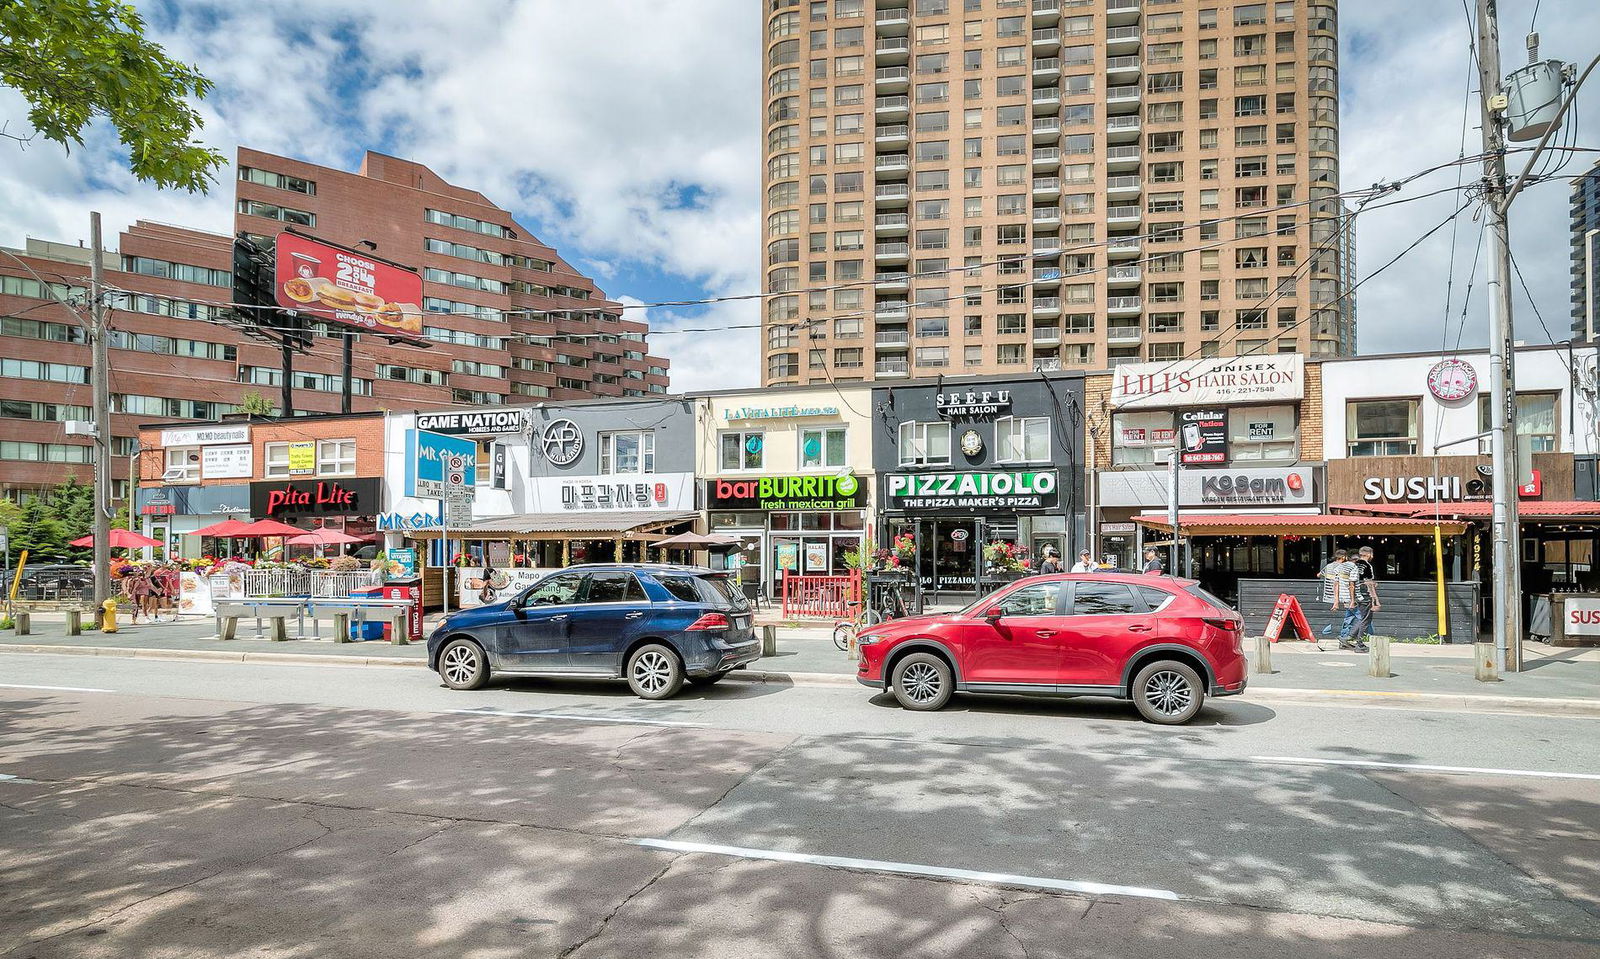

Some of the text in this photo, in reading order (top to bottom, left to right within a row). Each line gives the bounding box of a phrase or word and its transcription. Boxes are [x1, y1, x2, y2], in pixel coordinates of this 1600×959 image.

[336, 253, 375, 271] CHOOSE
[336, 262, 353, 282] 2
[336, 280, 374, 295] BREAKFAST
[1212, 363, 1276, 373] UNISEX
[1122, 371, 1192, 395] LILI'S
[1197, 371, 1294, 388] HAIR SALON
[936, 390, 1010, 406] SEEFU
[1238, 386, 1275, 394] 221-7548
[947, 405, 998, 415] HAIR SALON
[1182, 411, 1224, 421] Cellular
[418, 412, 520, 430] GAME NATION
[1250, 428, 1273, 436] RENT
[420, 445, 440, 461] MR.
[550, 452, 566, 463] HAIR
[888, 472, 1056, 497] PIZZAIOLO
[1363, 475, 1460, 500] SUSHI
[266, 482, 357, 515] Pita Lite
[760, 498, 855, 510] fresh mexican grill
[903, 497, 1040, 508] THE PIZZA MAKER'S PIZZA
[1473, 534, 1481, 571] 4924
[518, 571, 540, 580] Mapo
